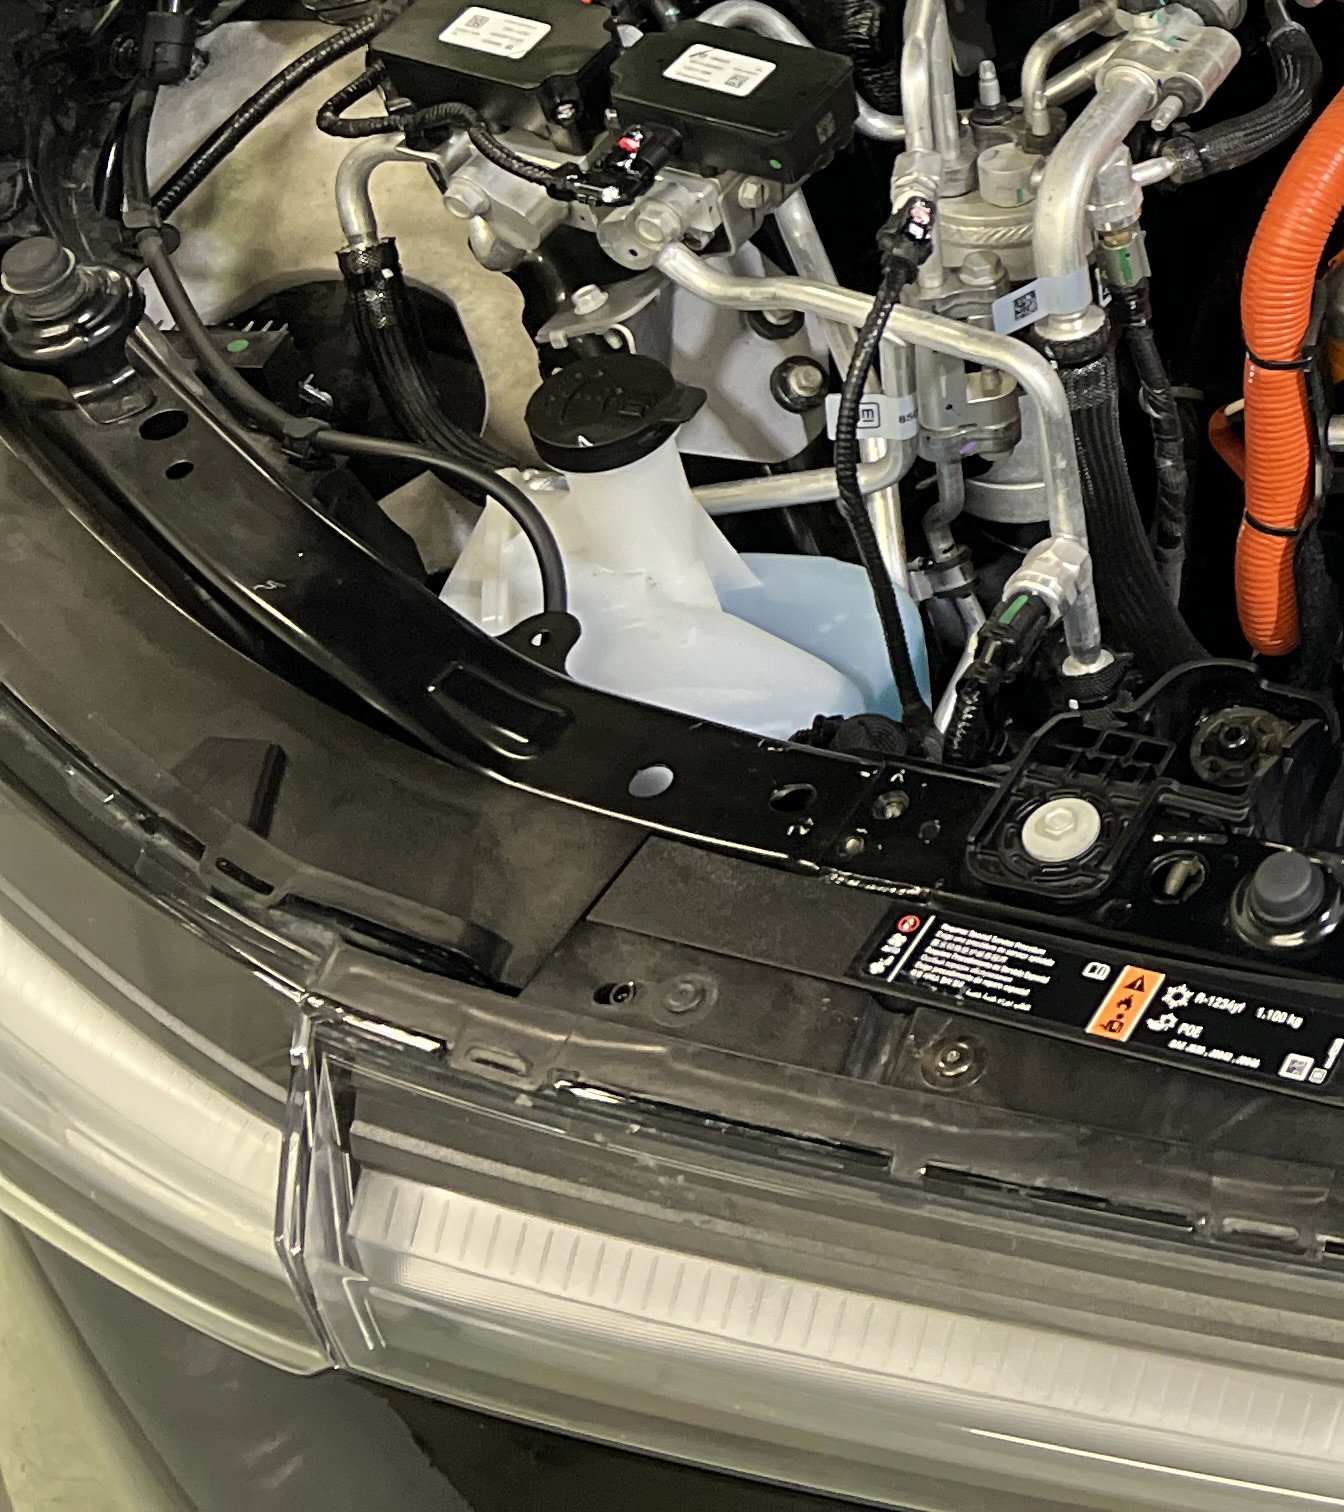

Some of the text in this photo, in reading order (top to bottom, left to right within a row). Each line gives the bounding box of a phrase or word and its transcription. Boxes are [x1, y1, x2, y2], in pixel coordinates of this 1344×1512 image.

[1194, 991, 1246, 1015] R-1234yf
[1286, 1013, 1305, 1030] kg
[1177, 1022, 1204, 1039] POE
